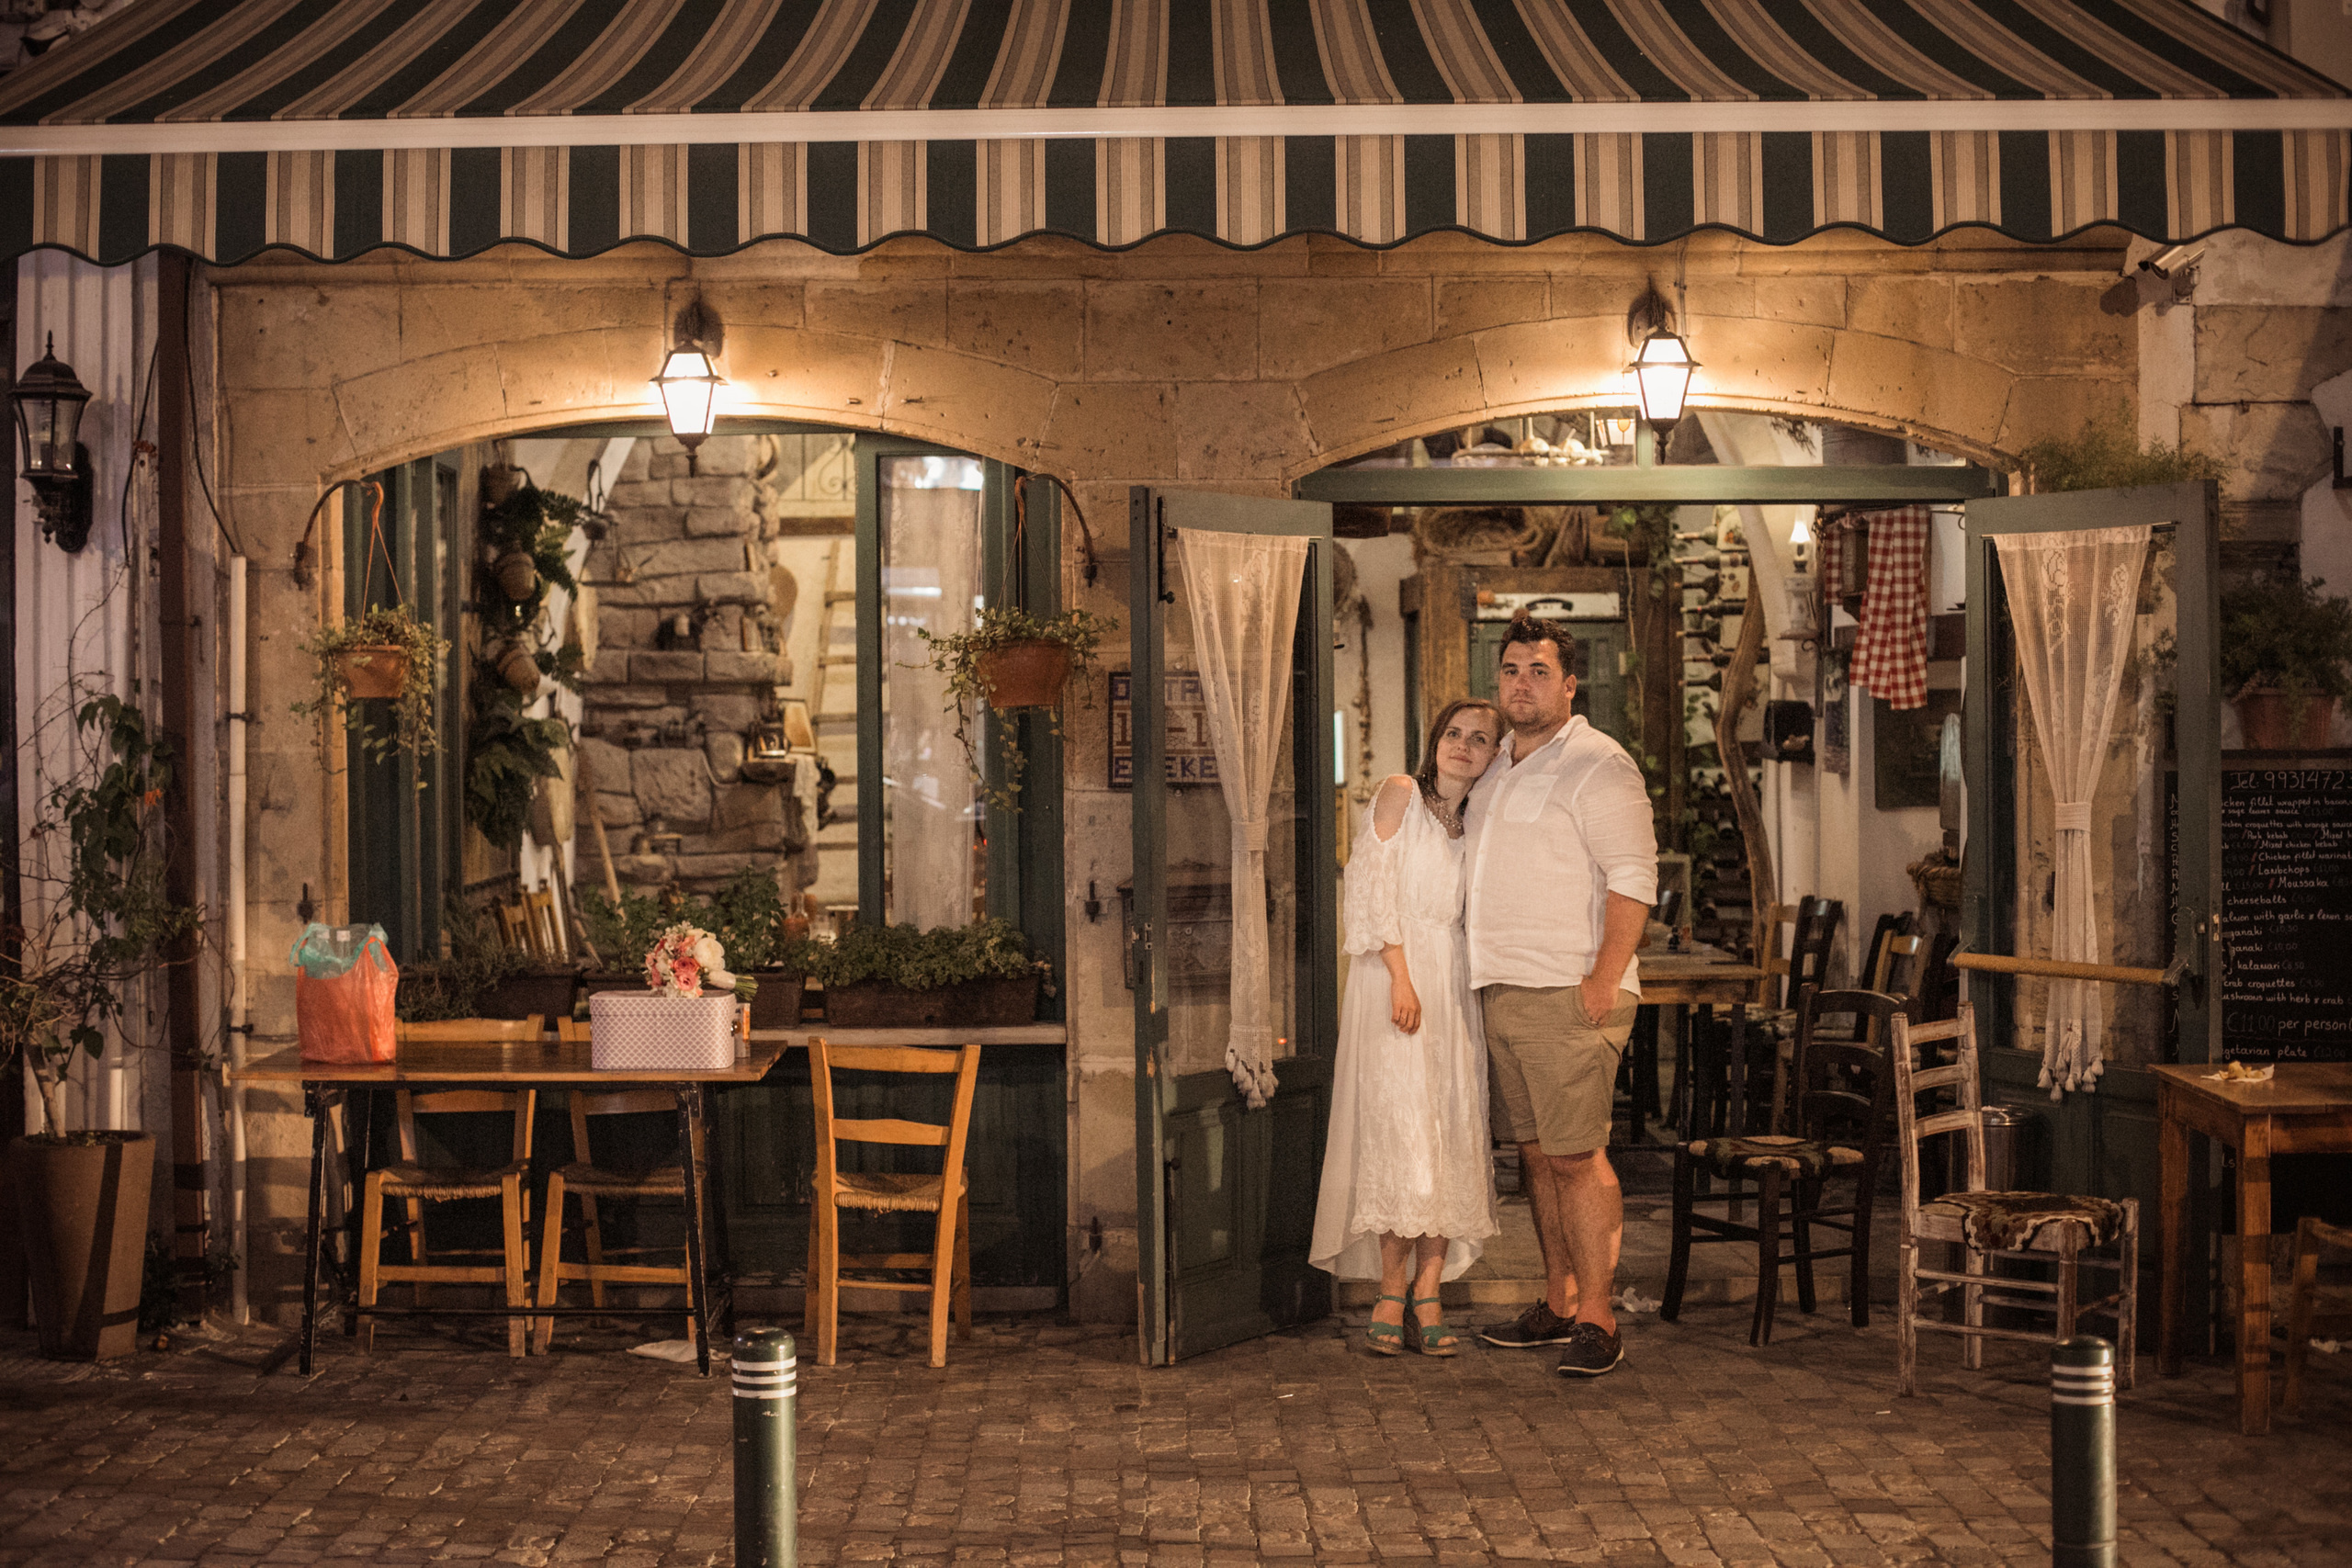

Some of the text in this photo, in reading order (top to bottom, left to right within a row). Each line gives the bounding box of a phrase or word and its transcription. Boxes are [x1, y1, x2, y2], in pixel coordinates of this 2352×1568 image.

[2229, 771, 2260, 790] Tel:
[2277, 796, 2312, 809] wrapped
[2245, 819, 2284, 829] croquettes
[2286, 820, 2303, 829] with
[2304, 822, 2329, 831] orange
[2266, 830, 2289, 840] kebab
[2320, 829, 2344, 840] Mixed
[2258, 840, 2283, 850] Mixed
[2285, 840, 2312, 849] chicken
[2314, 840, 2339, 849] kebab
[2257, 850, 2291, 862] Chicken
[2293, 850, 2316, 863] fillet
[2277, 875, 2330, 889] Moussaka
[2226, 894, 2288, 906] cheeseballs
[2222, 910, 2250, 923] almon
[2253, 909, 2276, 921] with
[2278, 908, 2306, 924] garlic
[2316, 908, 2342, 921] lemon
[2236, 959, 2280, 971] kalamari
[2222, 977, 2244, 987] crab
[2247, 976, 2296, 992] croquettes
[2266, 991, 2287, 1002] with
[2290, 992, 2311, 1004] herb
[2322, 995, 2344, 1005] crab
[2278, 1020, 2300, 1037] per
[2277, 1044, 2309, 1059] plate
